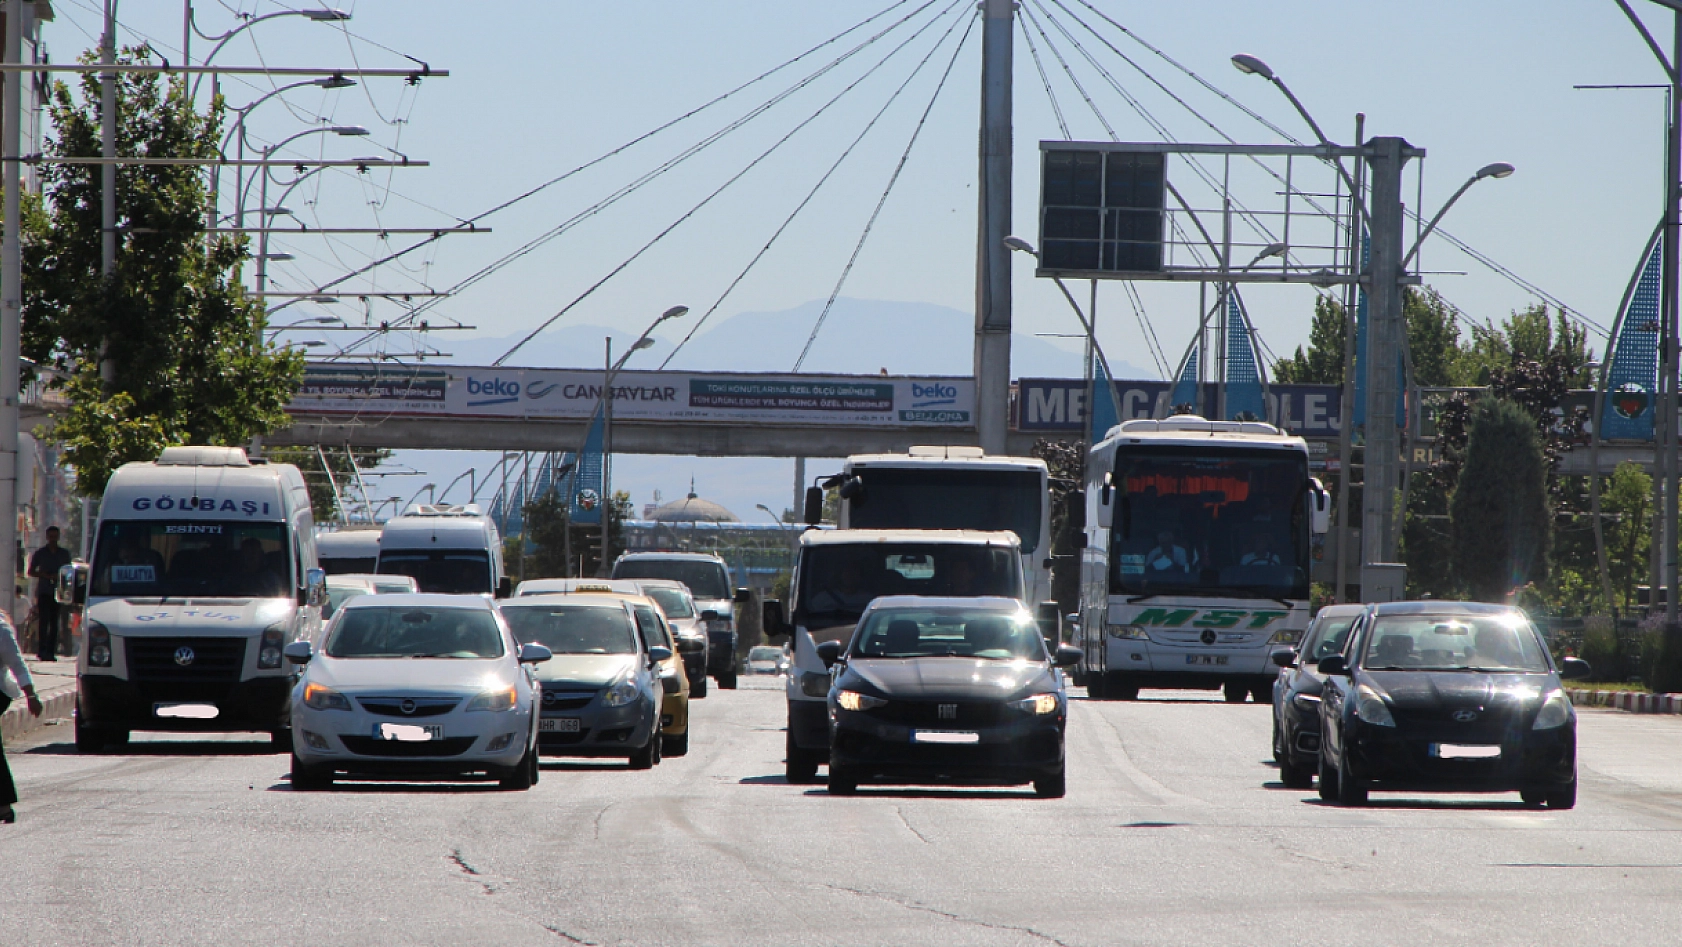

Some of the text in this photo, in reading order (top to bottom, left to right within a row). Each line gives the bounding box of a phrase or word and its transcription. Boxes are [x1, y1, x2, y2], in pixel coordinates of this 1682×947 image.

[466, 376, 520, 397] beko
[912, 382, 957, 398] beko
[905, 411, 964, 422] BELLONA
[132, 494, 270, 517] GÖLBAŞI
[165, 523, 224, 535] ESİNTİ
[116, 568, 153, 581] MALATYA
[1130, 608, 1291, 629] MST
[938, 703, 958, 719] FIAT
